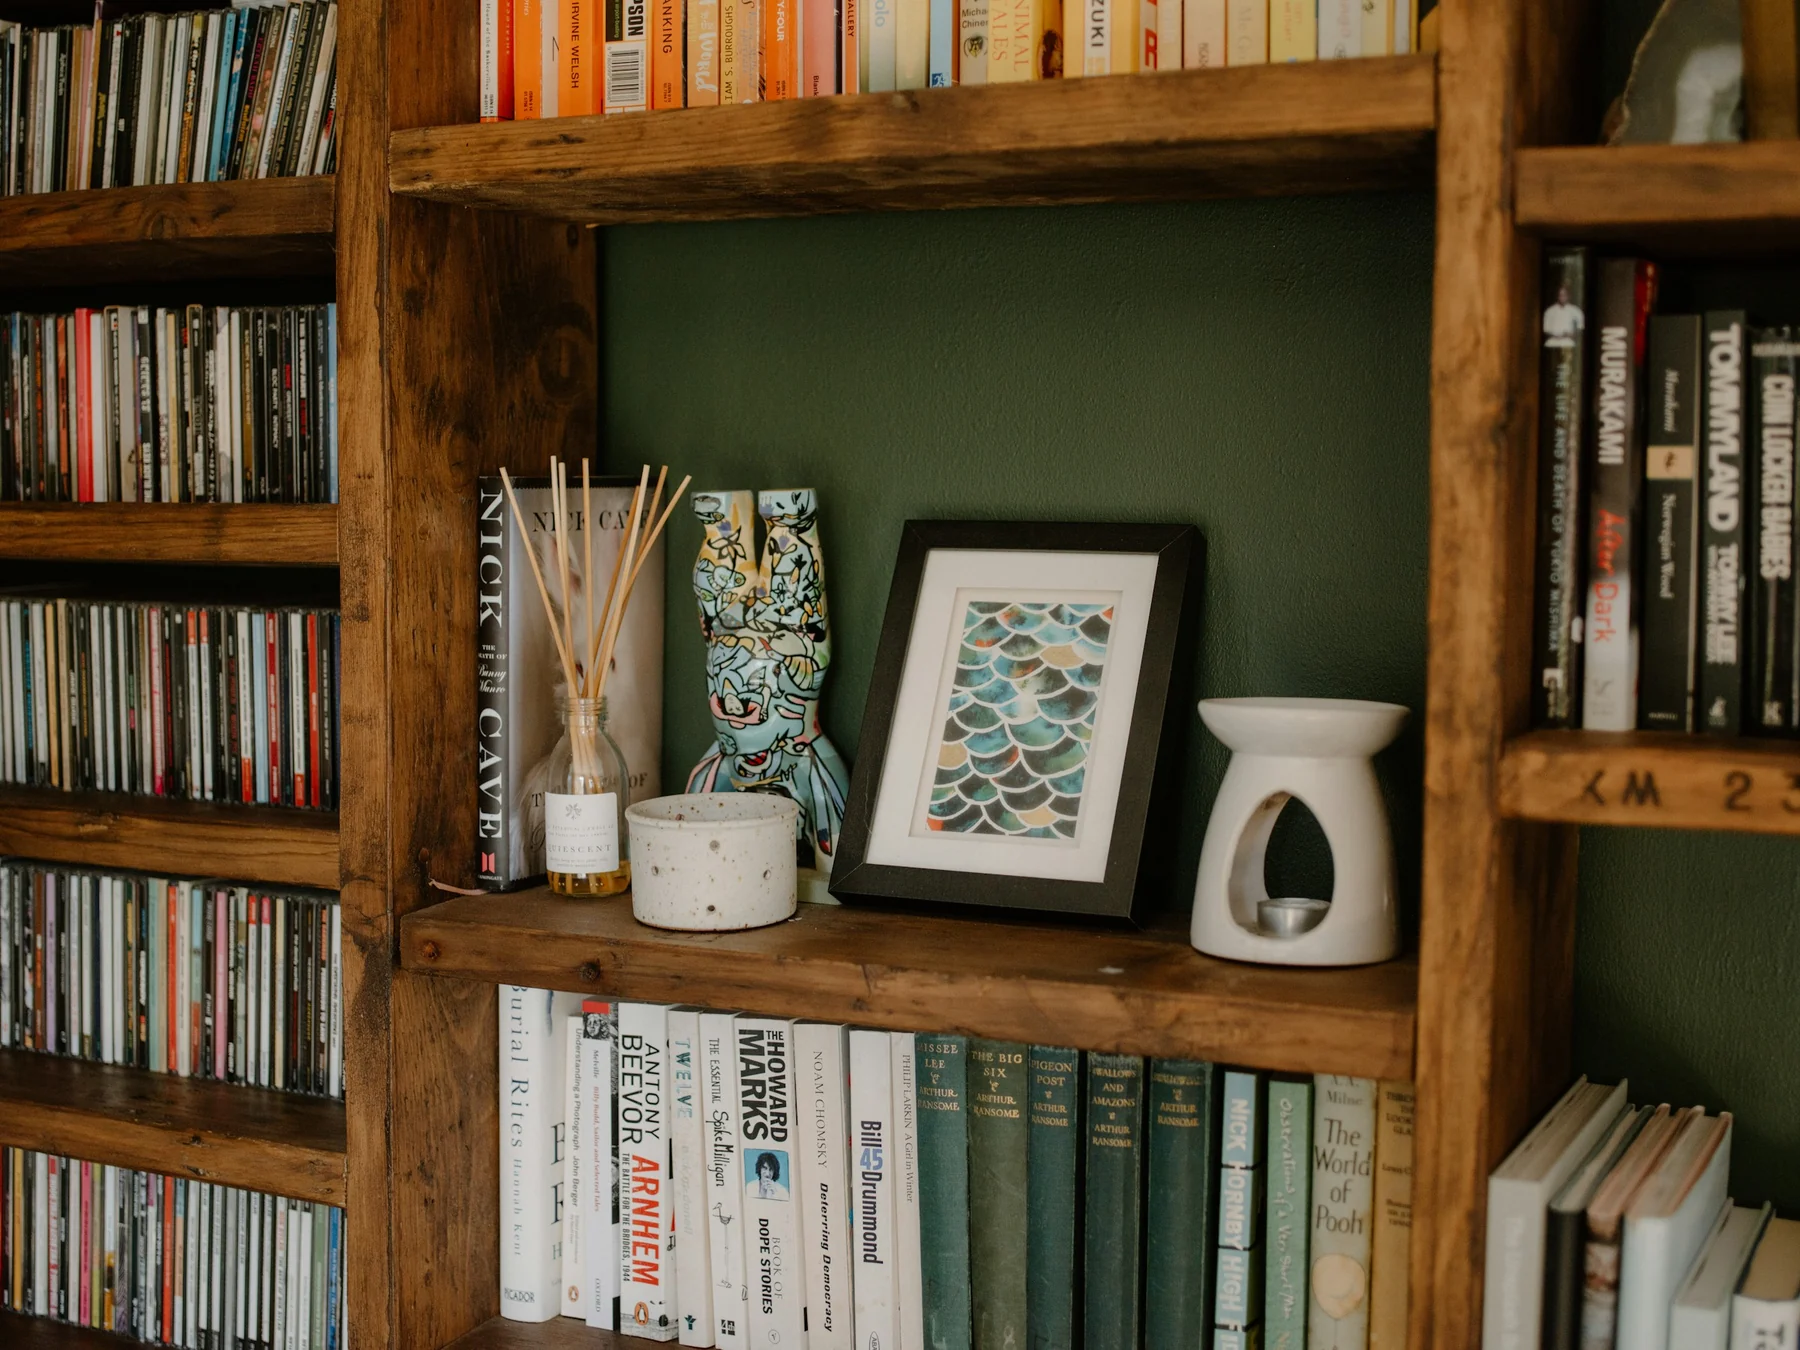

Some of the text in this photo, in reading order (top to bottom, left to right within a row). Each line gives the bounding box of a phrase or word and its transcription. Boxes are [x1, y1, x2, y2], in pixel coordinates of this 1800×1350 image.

[571, 2, 579, 88] IRVINE WELSH
[725, 6, 733, 63] BURROUGHS
[1597, 326, 1627, 465] MURAKAMI
[1662, 368, 1679, 432] Murakami
[1762, 375, 1793, 424] COIN
[1708, 323, 1740, 531] TOMMYLAND
[1761, 427, 1791, 504] LOCKER
[1551, 465, 1565, 508] DEATH
[479, 488, 503, 628] NICK
[1658, 494, 1676, 599] Norwegian Wood
[1760, 507, 1791, 580] BABIES
[1547, 589, 1560, 651] MISHIMA
[1592, 583, 1619, 643] Dark
[1716, 543, 1738, 665] TOMMY LEE
[478, 707, 503, 839] CAVE
[766, 1029, 784, 1041] THE
[917, 1043, 958, 1054] MISSEE
[571, 1028, 583, 1091] Understanding
[925, 1059, 945, 1068] LEE
[972, 1051, 1022, 1063] THE BIG
[984, 1067, 1007, 1078] SIX
[1031, 1060, 1072, 1072] PIGEON
[592, 1086, 601, 1102] Billy
[621, 1034, 643, 1145] BEEVOR
[645, 1043, 660, 1140] ANTONY
[675, 1037, 693, 1118] TWELVE
[738, 1028, 770, 1141] MARKS
[766, 1041, 788, 1143] HOWARD
[920, 1086, 958, 1097] ARTHUR
[1037, 1075, 1066, 1086] POST
[1103, 1083, 1124, 1093] AND
[510, 1078, 530, 1148] Rites
[592, 1104, 601, 1126] Budd,
[706, 1038, 734, 1187] THE ESSENTIAL Spike Milligan
[813, 1050, 828, 1169] NOAM CHOMSKY
[917, 1099, 960, 1111] RANSOME
[974, 1105, 1019, 1118] RANSOME
[977, 1093, 1016, 1104] ARTHUR
[1033, 1103, 1067, 1113] ARTHUR
[1092, 1096, 1135, 1107] AMAZONS
[1160, 1102, 1197, 1112] ARTHUR
[1326, 1090, 1363, 1106] Milne
[571, 1100, 581, 1150] Photograph
[593, 1126, 601, 1147] Sailor
[860, 1120, 883, 1147] Bill
[902, 1054, 914, 1203] PHILIP LARKIN A Girl in Winter
[1031, 1115, 1069, 1127] RANSOME
[1094, 1124, 1131, 1134] ARTHUR
[1157, 1116, 1200, 1127] RANSOME
[1226, 1098, 1251, 1152] NICK
[1324, 1117, 1362, 1147] The
[593, 1148, 601, 1163] and
[859, 1147, 884, 1171] 45
[1092, 1137, 1132, 1148] RANSOME
[1279, 1098, 1296, 1194] Observations
[572, 1155, 580, 1171] John
[1314, 1145, 1372, 1176] World
[512, 1158, 523, 1215] Hannah
[570, 1172, 580, 1207] Berger
[593, 1164, 601, 1193] Selected
[1330, 1179, 1354, 1203] of
[621, 1153, 630, 1282] THE BATTLE FOR THE BRIDGES, 1944
[861, 1171, 884, 1264] Drummond
[1224, 1160, 1246, 1250] HORNBY
[1273, 1192, 1293, 1211] of
[632, 1154, 660, 1286] ARNHEM
[1316, 1205, 1363, 1235] Pooh
[513, 1223, 523, 1256] Kent
[1277, 1225, 1291, 1251] Very
[758, 1218, 773, 1315] DOPE STORIES
[773, 1236, 783, 1300] BOOK OF
[819, 1182, 834, 1333] Deterring Democracy
[1279, 1255, 1293, 1288] Short
[504, 1287, 536, 1303] PICADOR
[594, 1277, 602, 1313] OXFORD
[1219, 1255, 1243, 1311] HIGH
[1283, 1292, 1296, 1320] Man
